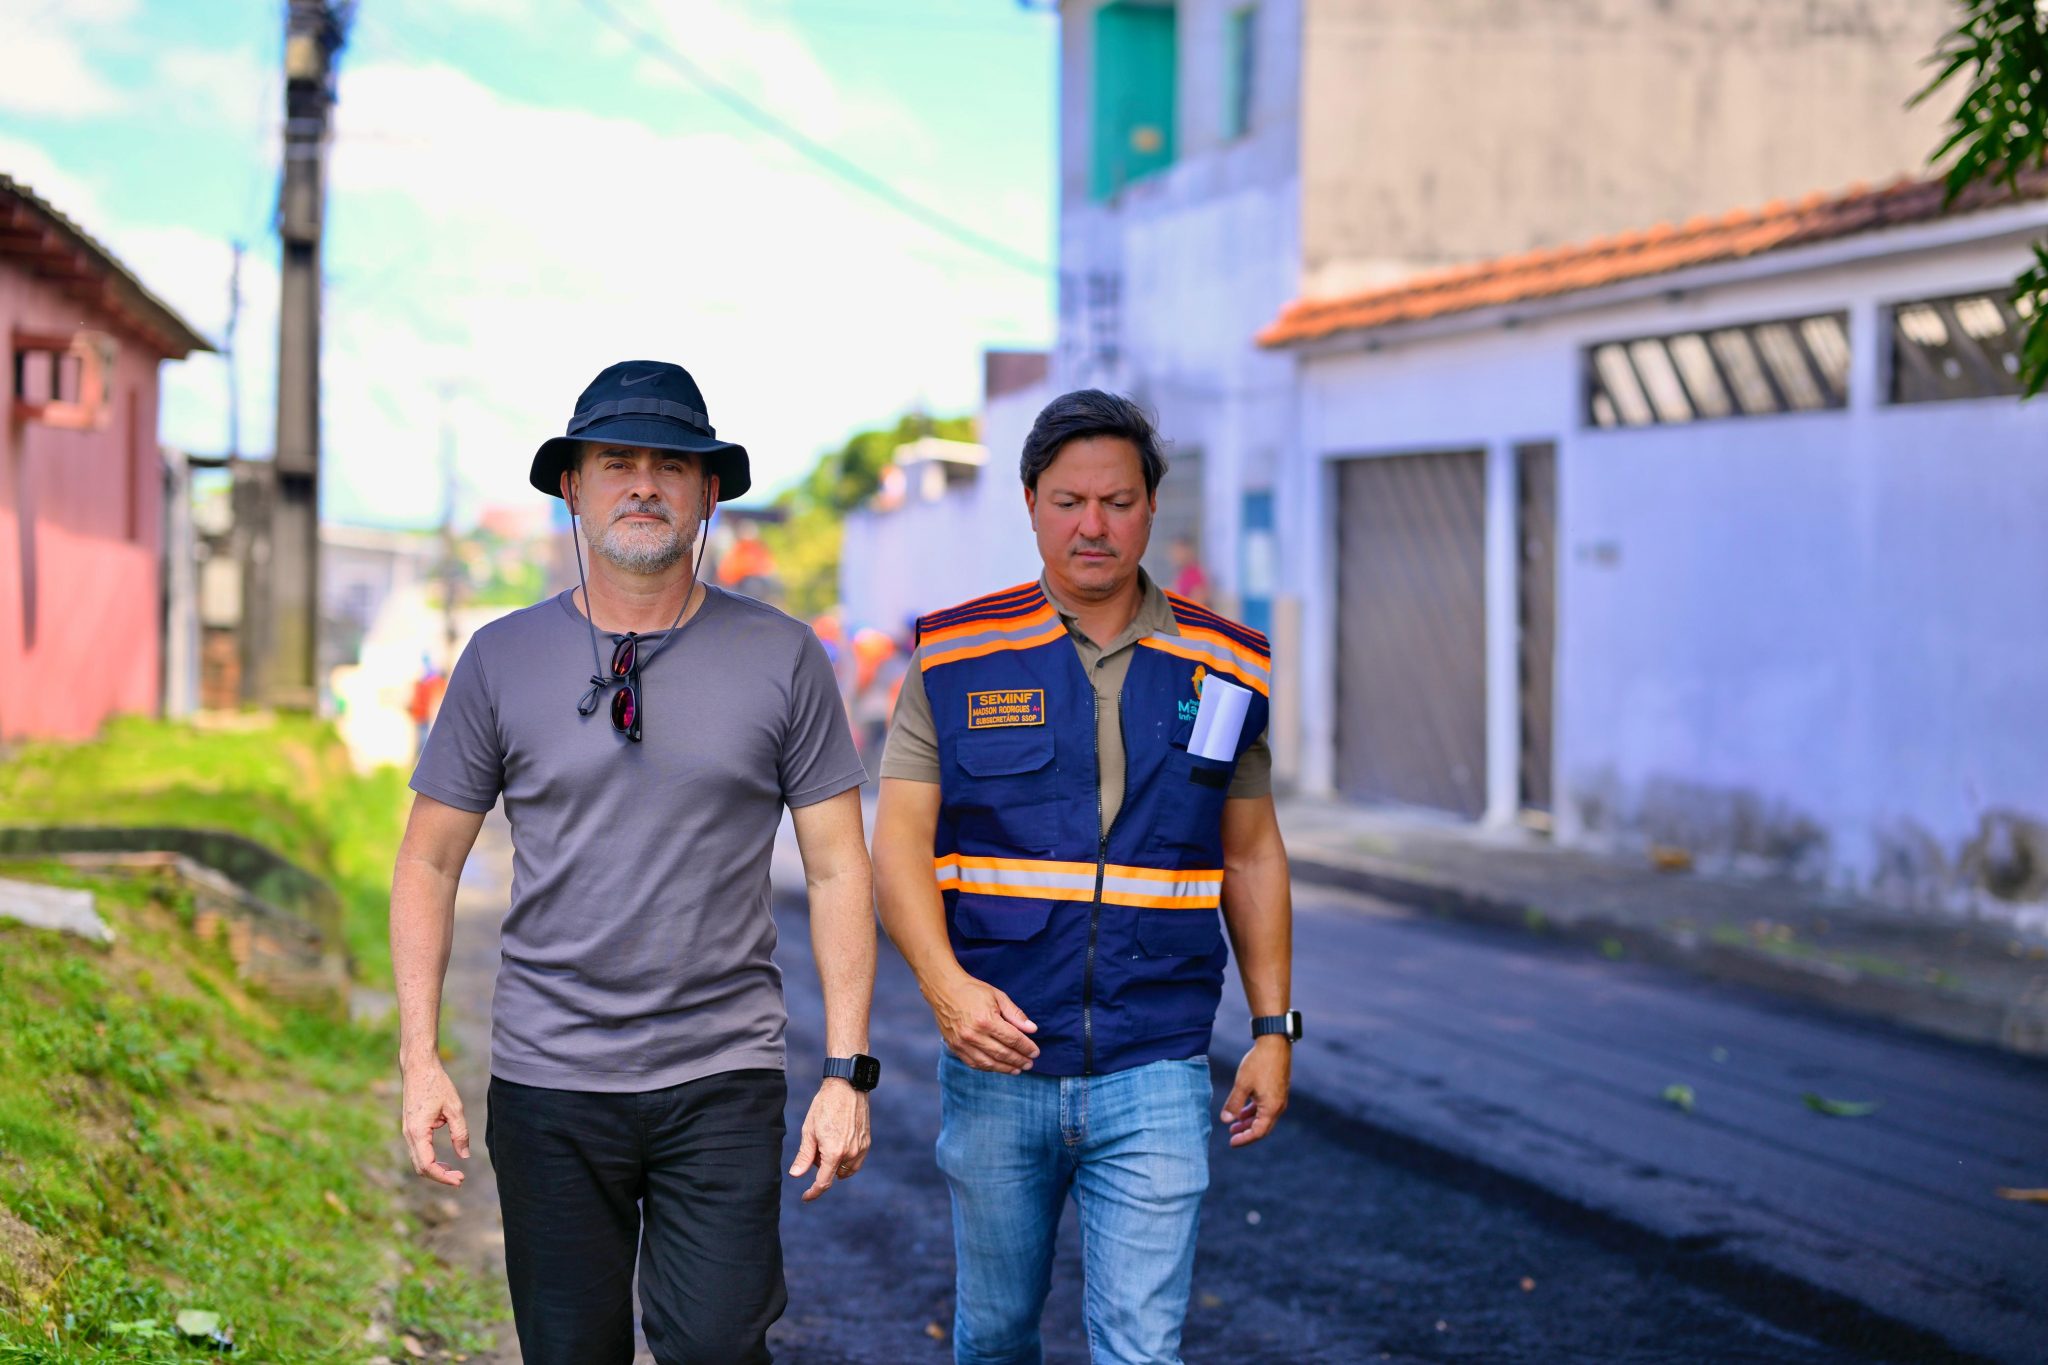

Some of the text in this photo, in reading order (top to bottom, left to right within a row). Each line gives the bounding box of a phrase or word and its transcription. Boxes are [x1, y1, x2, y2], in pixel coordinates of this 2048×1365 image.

[979, 693, 1033, 705] SEMINF
[973, 707, 997, 716] MADSON
[999, 705, 1030, 713] RODRIGUES
[976, 713, 1037, 724] SUBSECRETÁRIO SSOP
